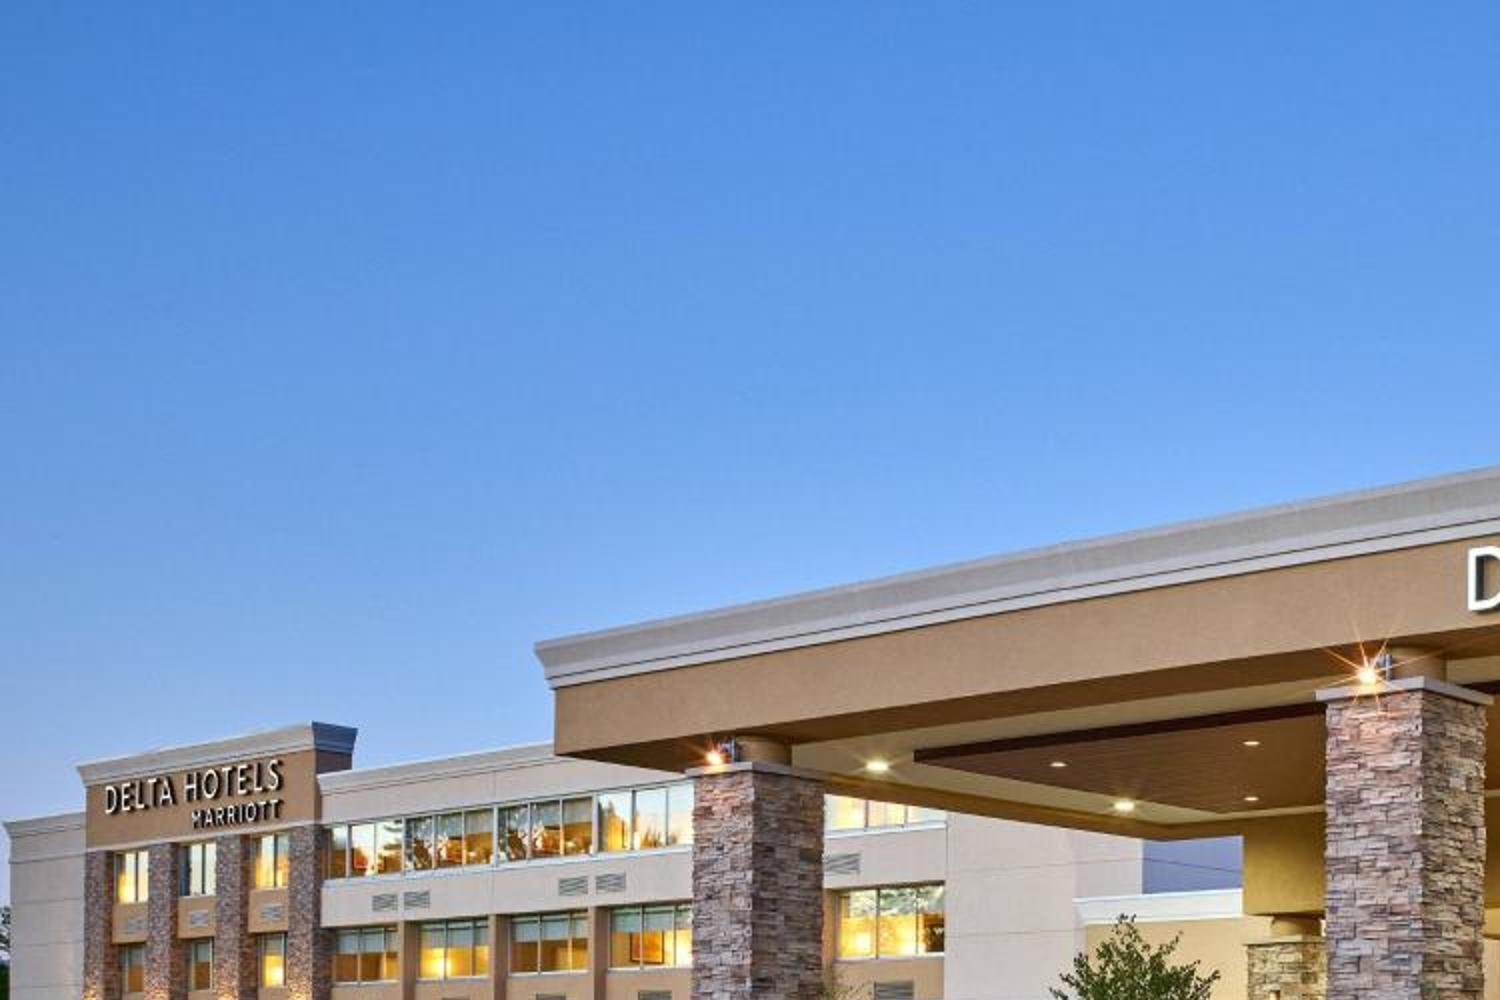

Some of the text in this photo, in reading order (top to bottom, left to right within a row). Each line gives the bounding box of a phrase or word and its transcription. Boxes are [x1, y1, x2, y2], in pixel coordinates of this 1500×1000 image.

[104, 758, 282, 816] DELTA HOTELS
[190, 799, 281, 829] MARRIOTT
